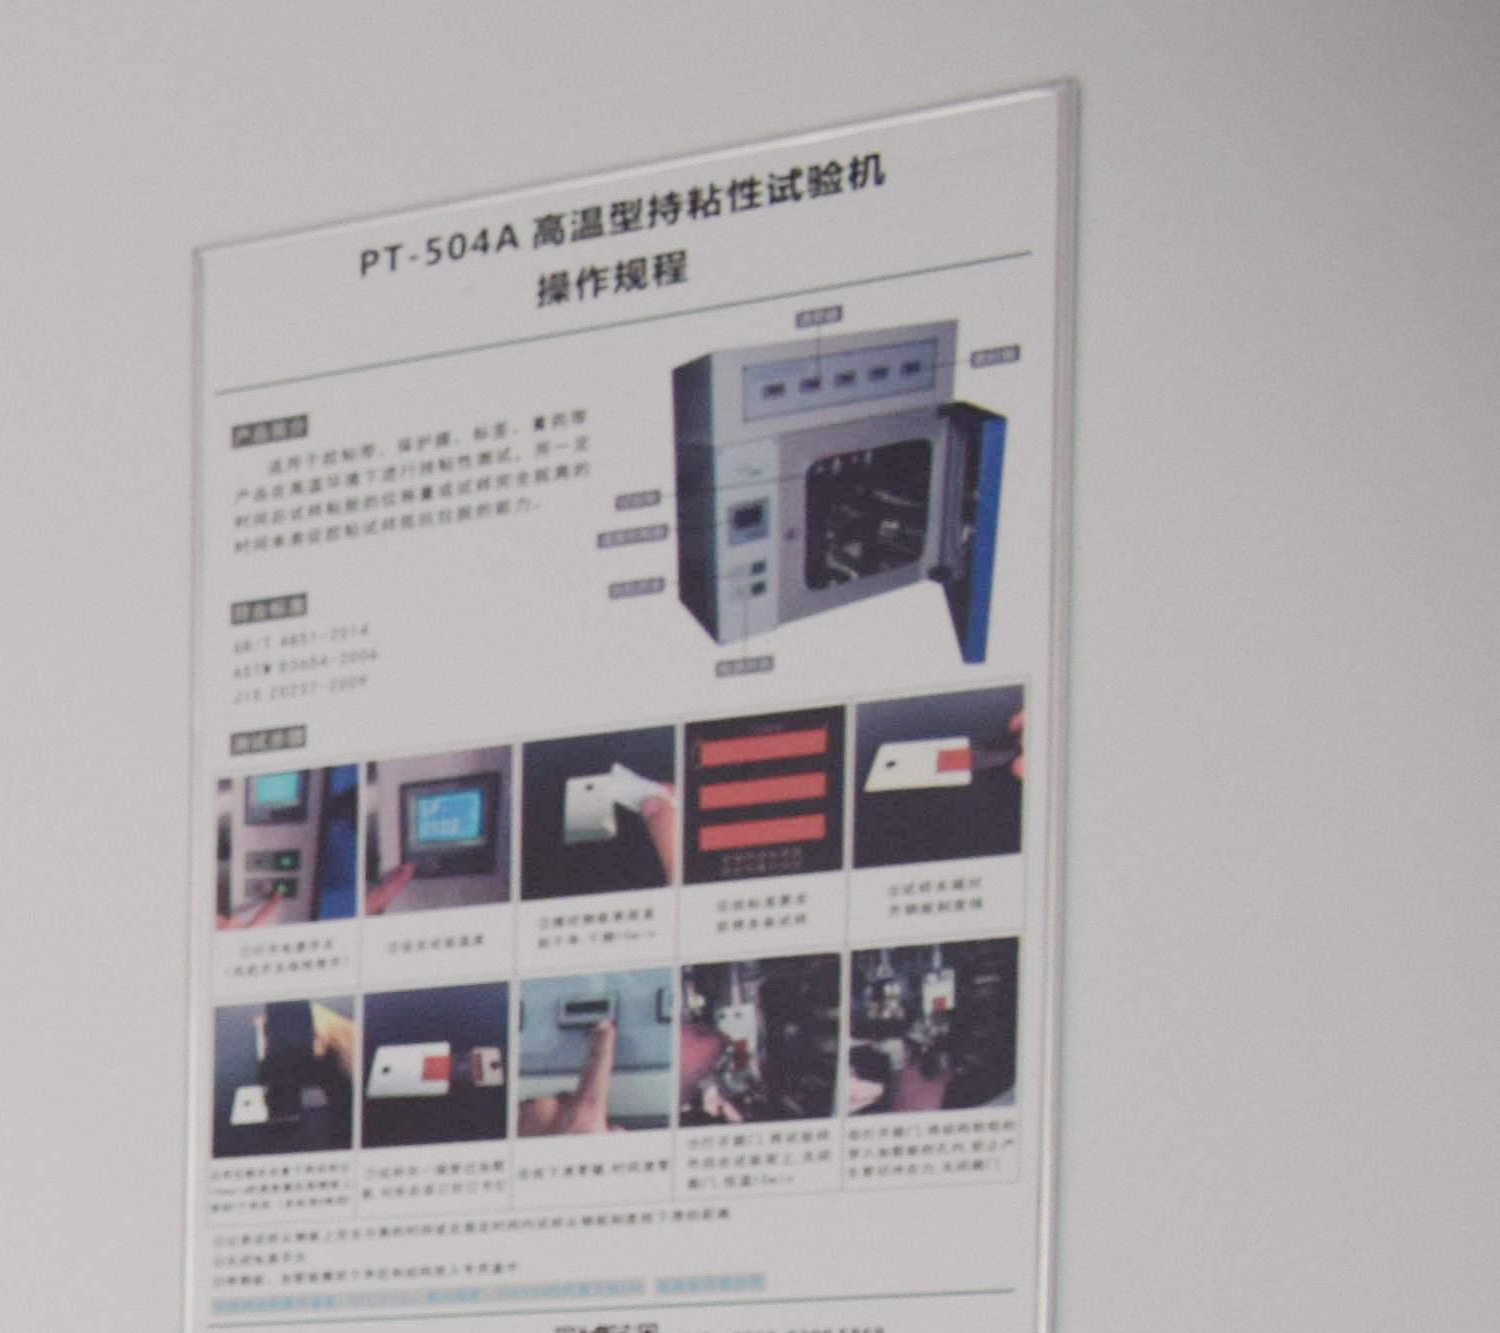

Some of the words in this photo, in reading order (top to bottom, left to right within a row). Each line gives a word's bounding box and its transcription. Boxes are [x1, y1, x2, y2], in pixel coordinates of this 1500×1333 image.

[359, 224, 520, 277] PT-504A
[531, 153, 888, 249] 高温型持粘性试验机
[536, 248, 690, 309] 操作规程
